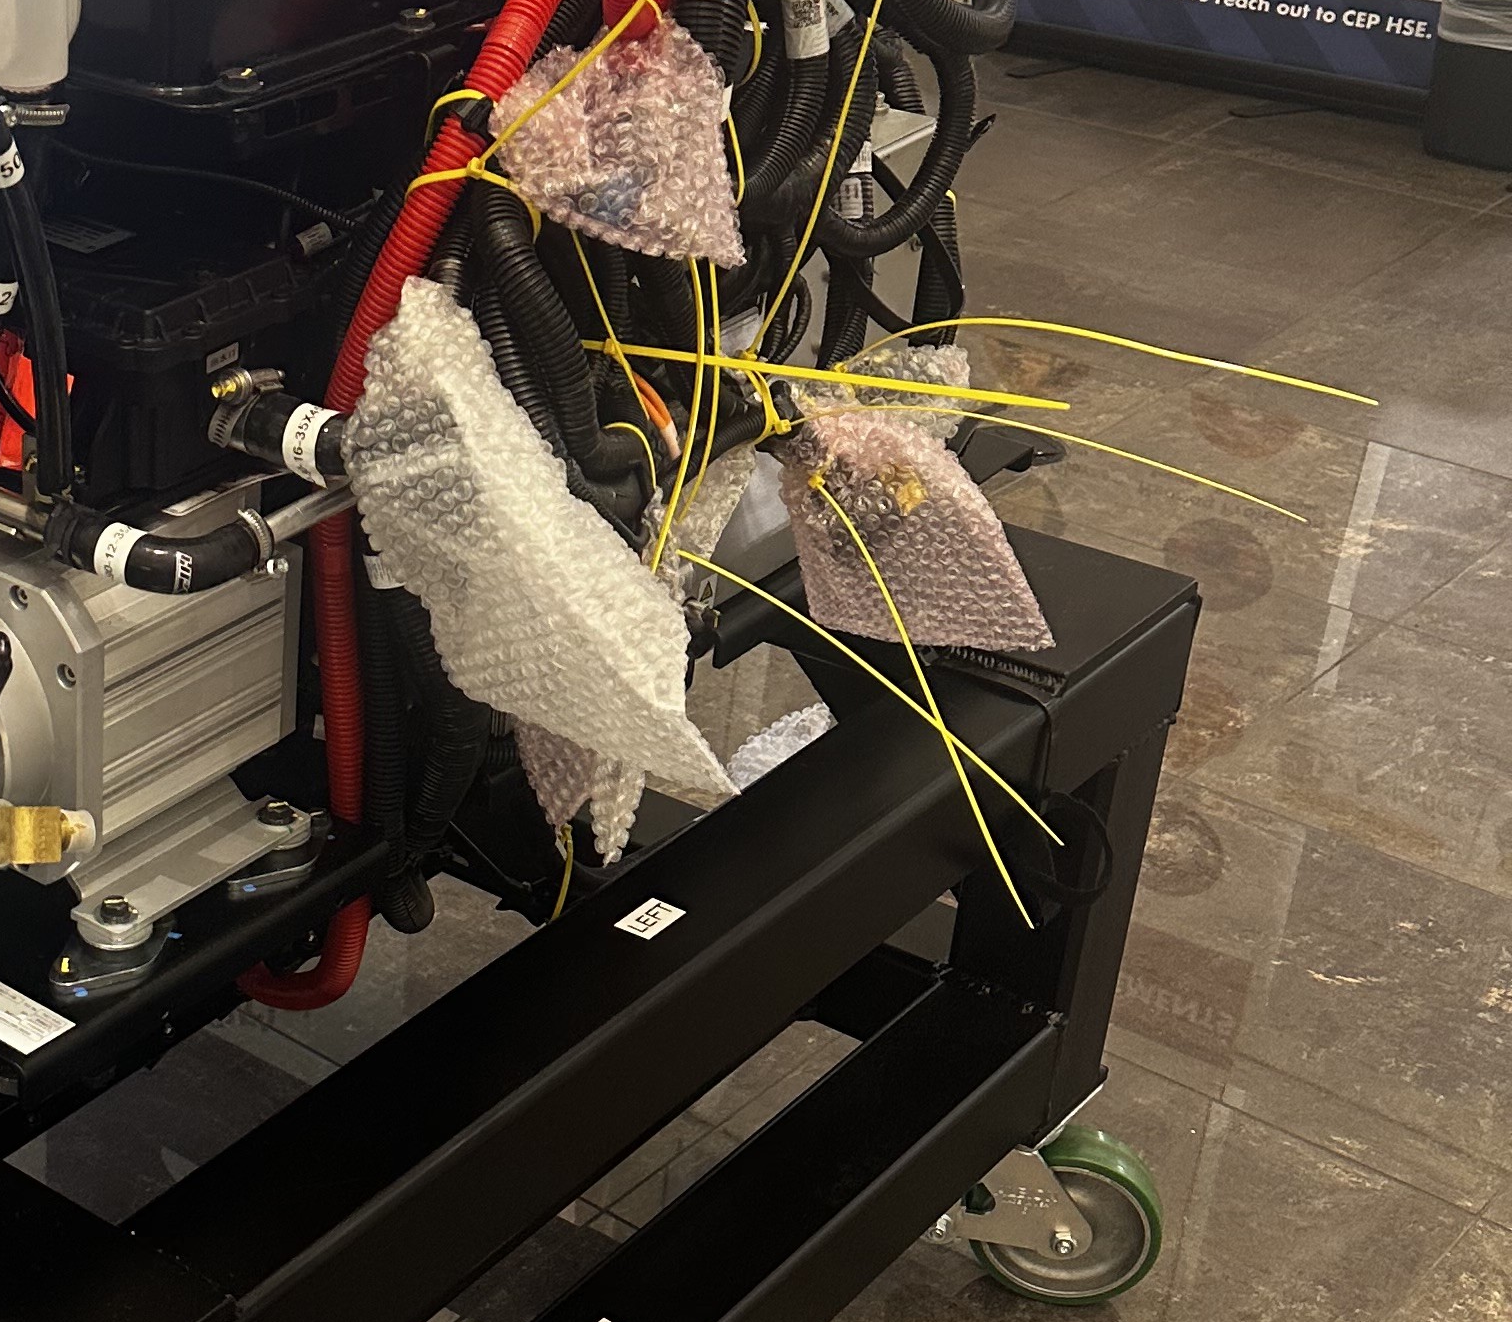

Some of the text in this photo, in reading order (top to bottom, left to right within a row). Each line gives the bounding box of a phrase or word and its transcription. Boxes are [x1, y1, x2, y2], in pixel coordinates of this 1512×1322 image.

[1277, 0, 1311, 19] out
[1315, 7, 1336, 24] to
[1342, 9, 1381, 30] CEP
[1385, 16, 1432, 40] HSE.
[627, 902, 672, 933] LEFT
